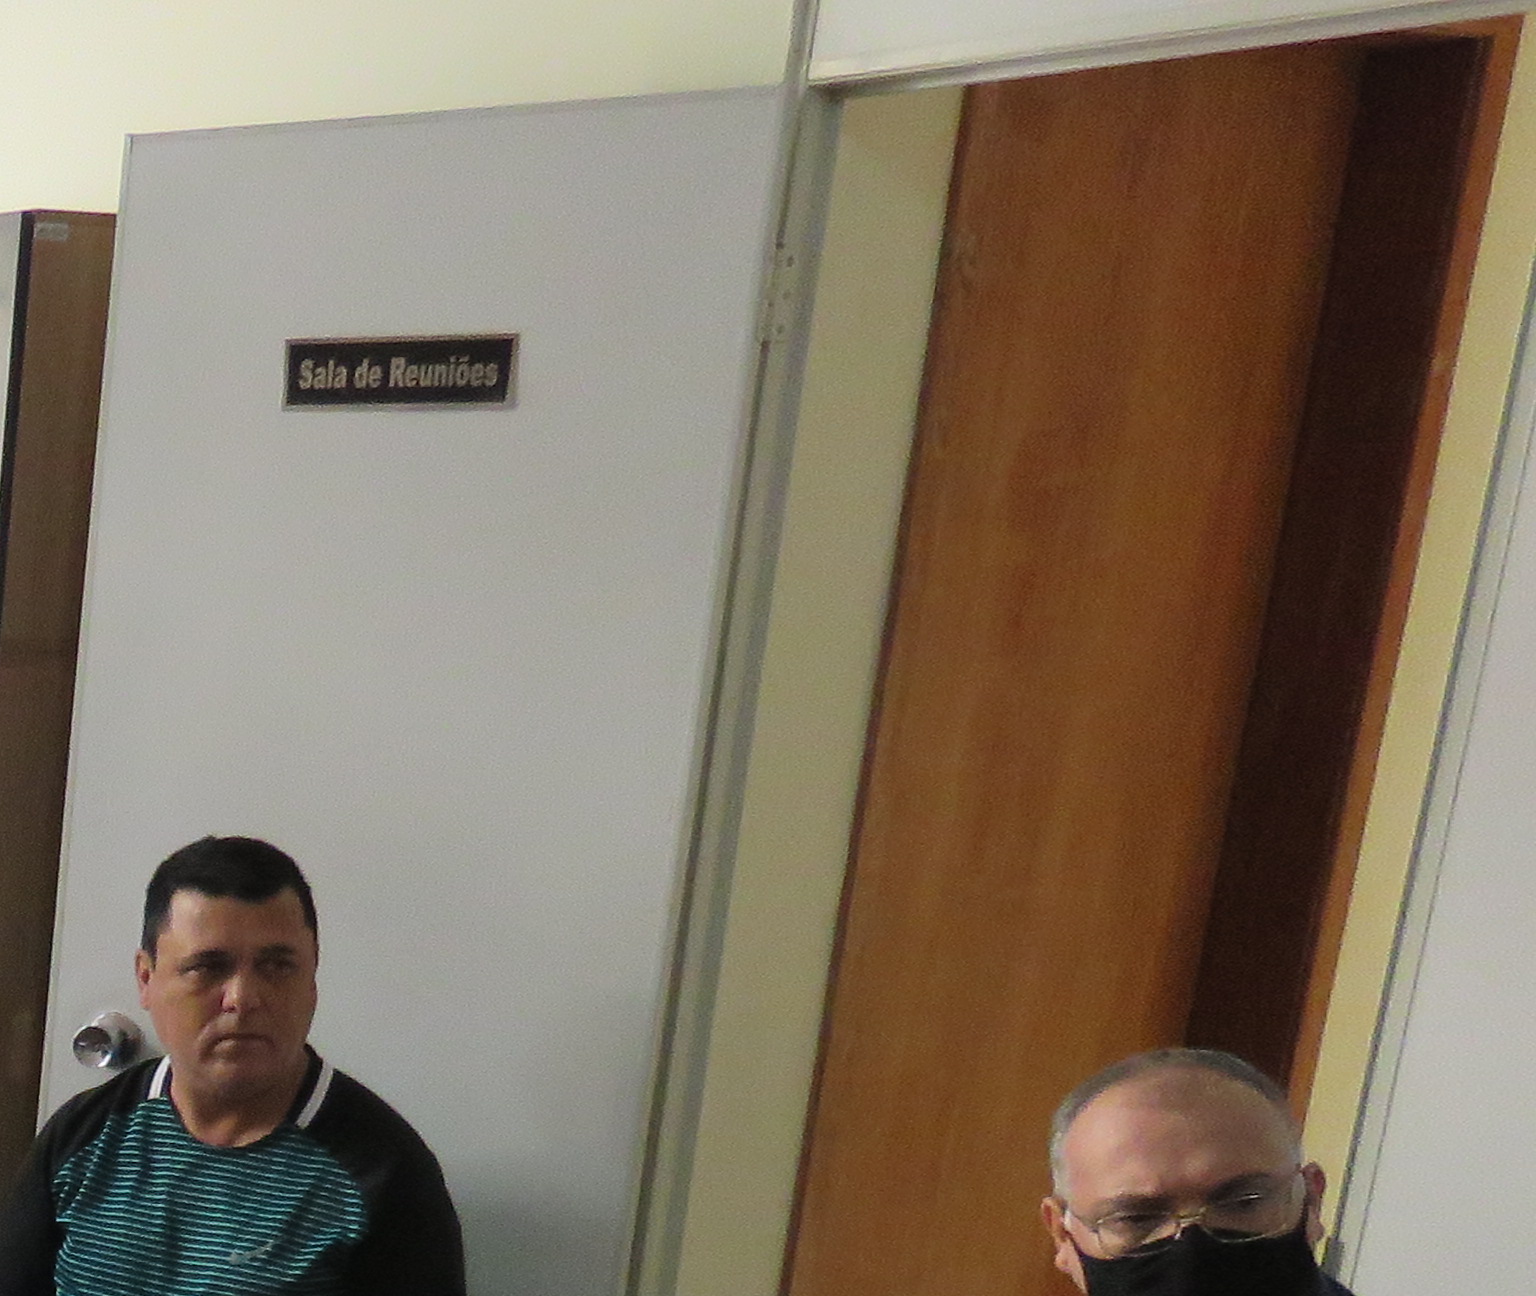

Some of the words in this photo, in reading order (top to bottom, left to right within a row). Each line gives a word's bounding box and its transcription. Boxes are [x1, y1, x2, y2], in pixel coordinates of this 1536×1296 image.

[299, 358, 347, 389] Sala
[354, 358, 382, 388] de
[389, 355, 498, 387] Reuniões
